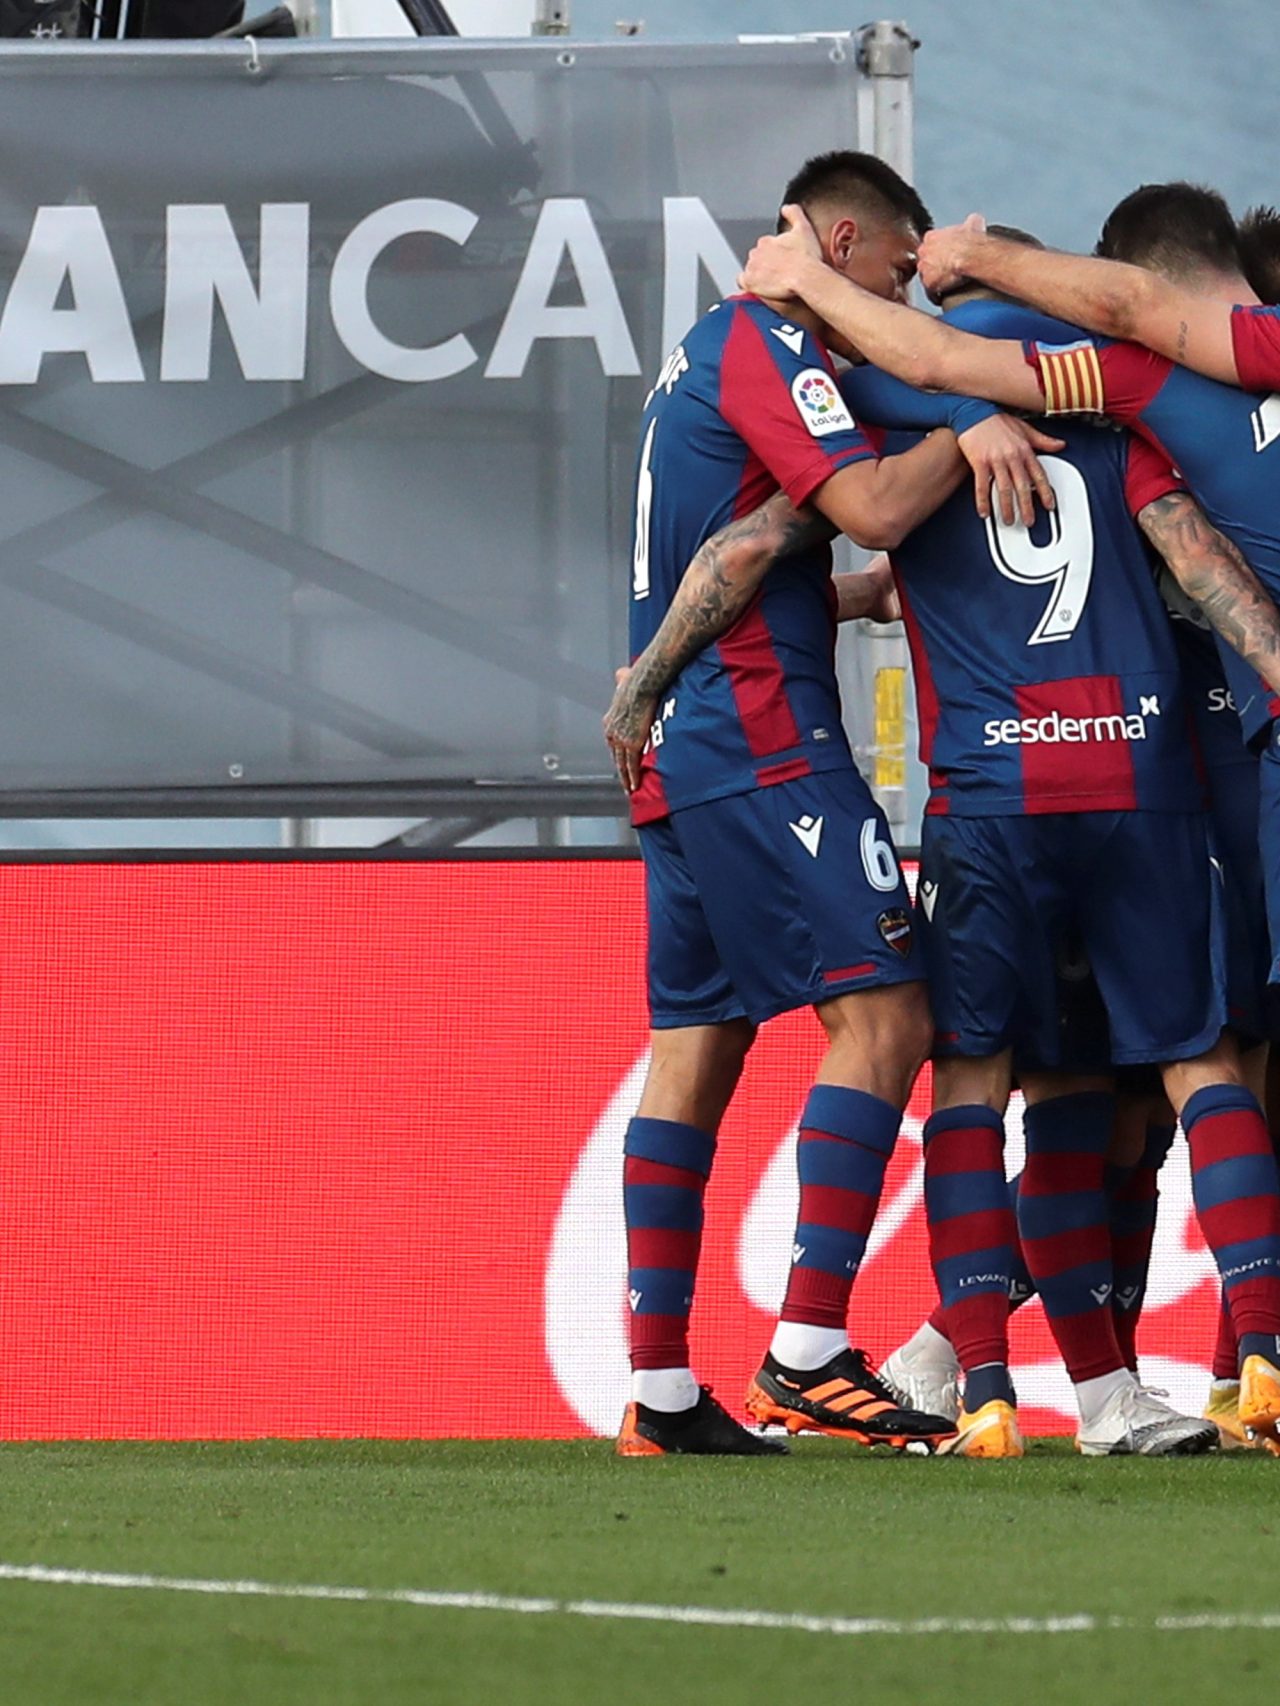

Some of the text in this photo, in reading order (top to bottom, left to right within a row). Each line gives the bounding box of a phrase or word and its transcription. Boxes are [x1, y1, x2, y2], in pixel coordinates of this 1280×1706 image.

[984, 454, 1095, 647] 9
[983, 712, 1147, 747] sesderma
[859, 818, 901, 893] 6
